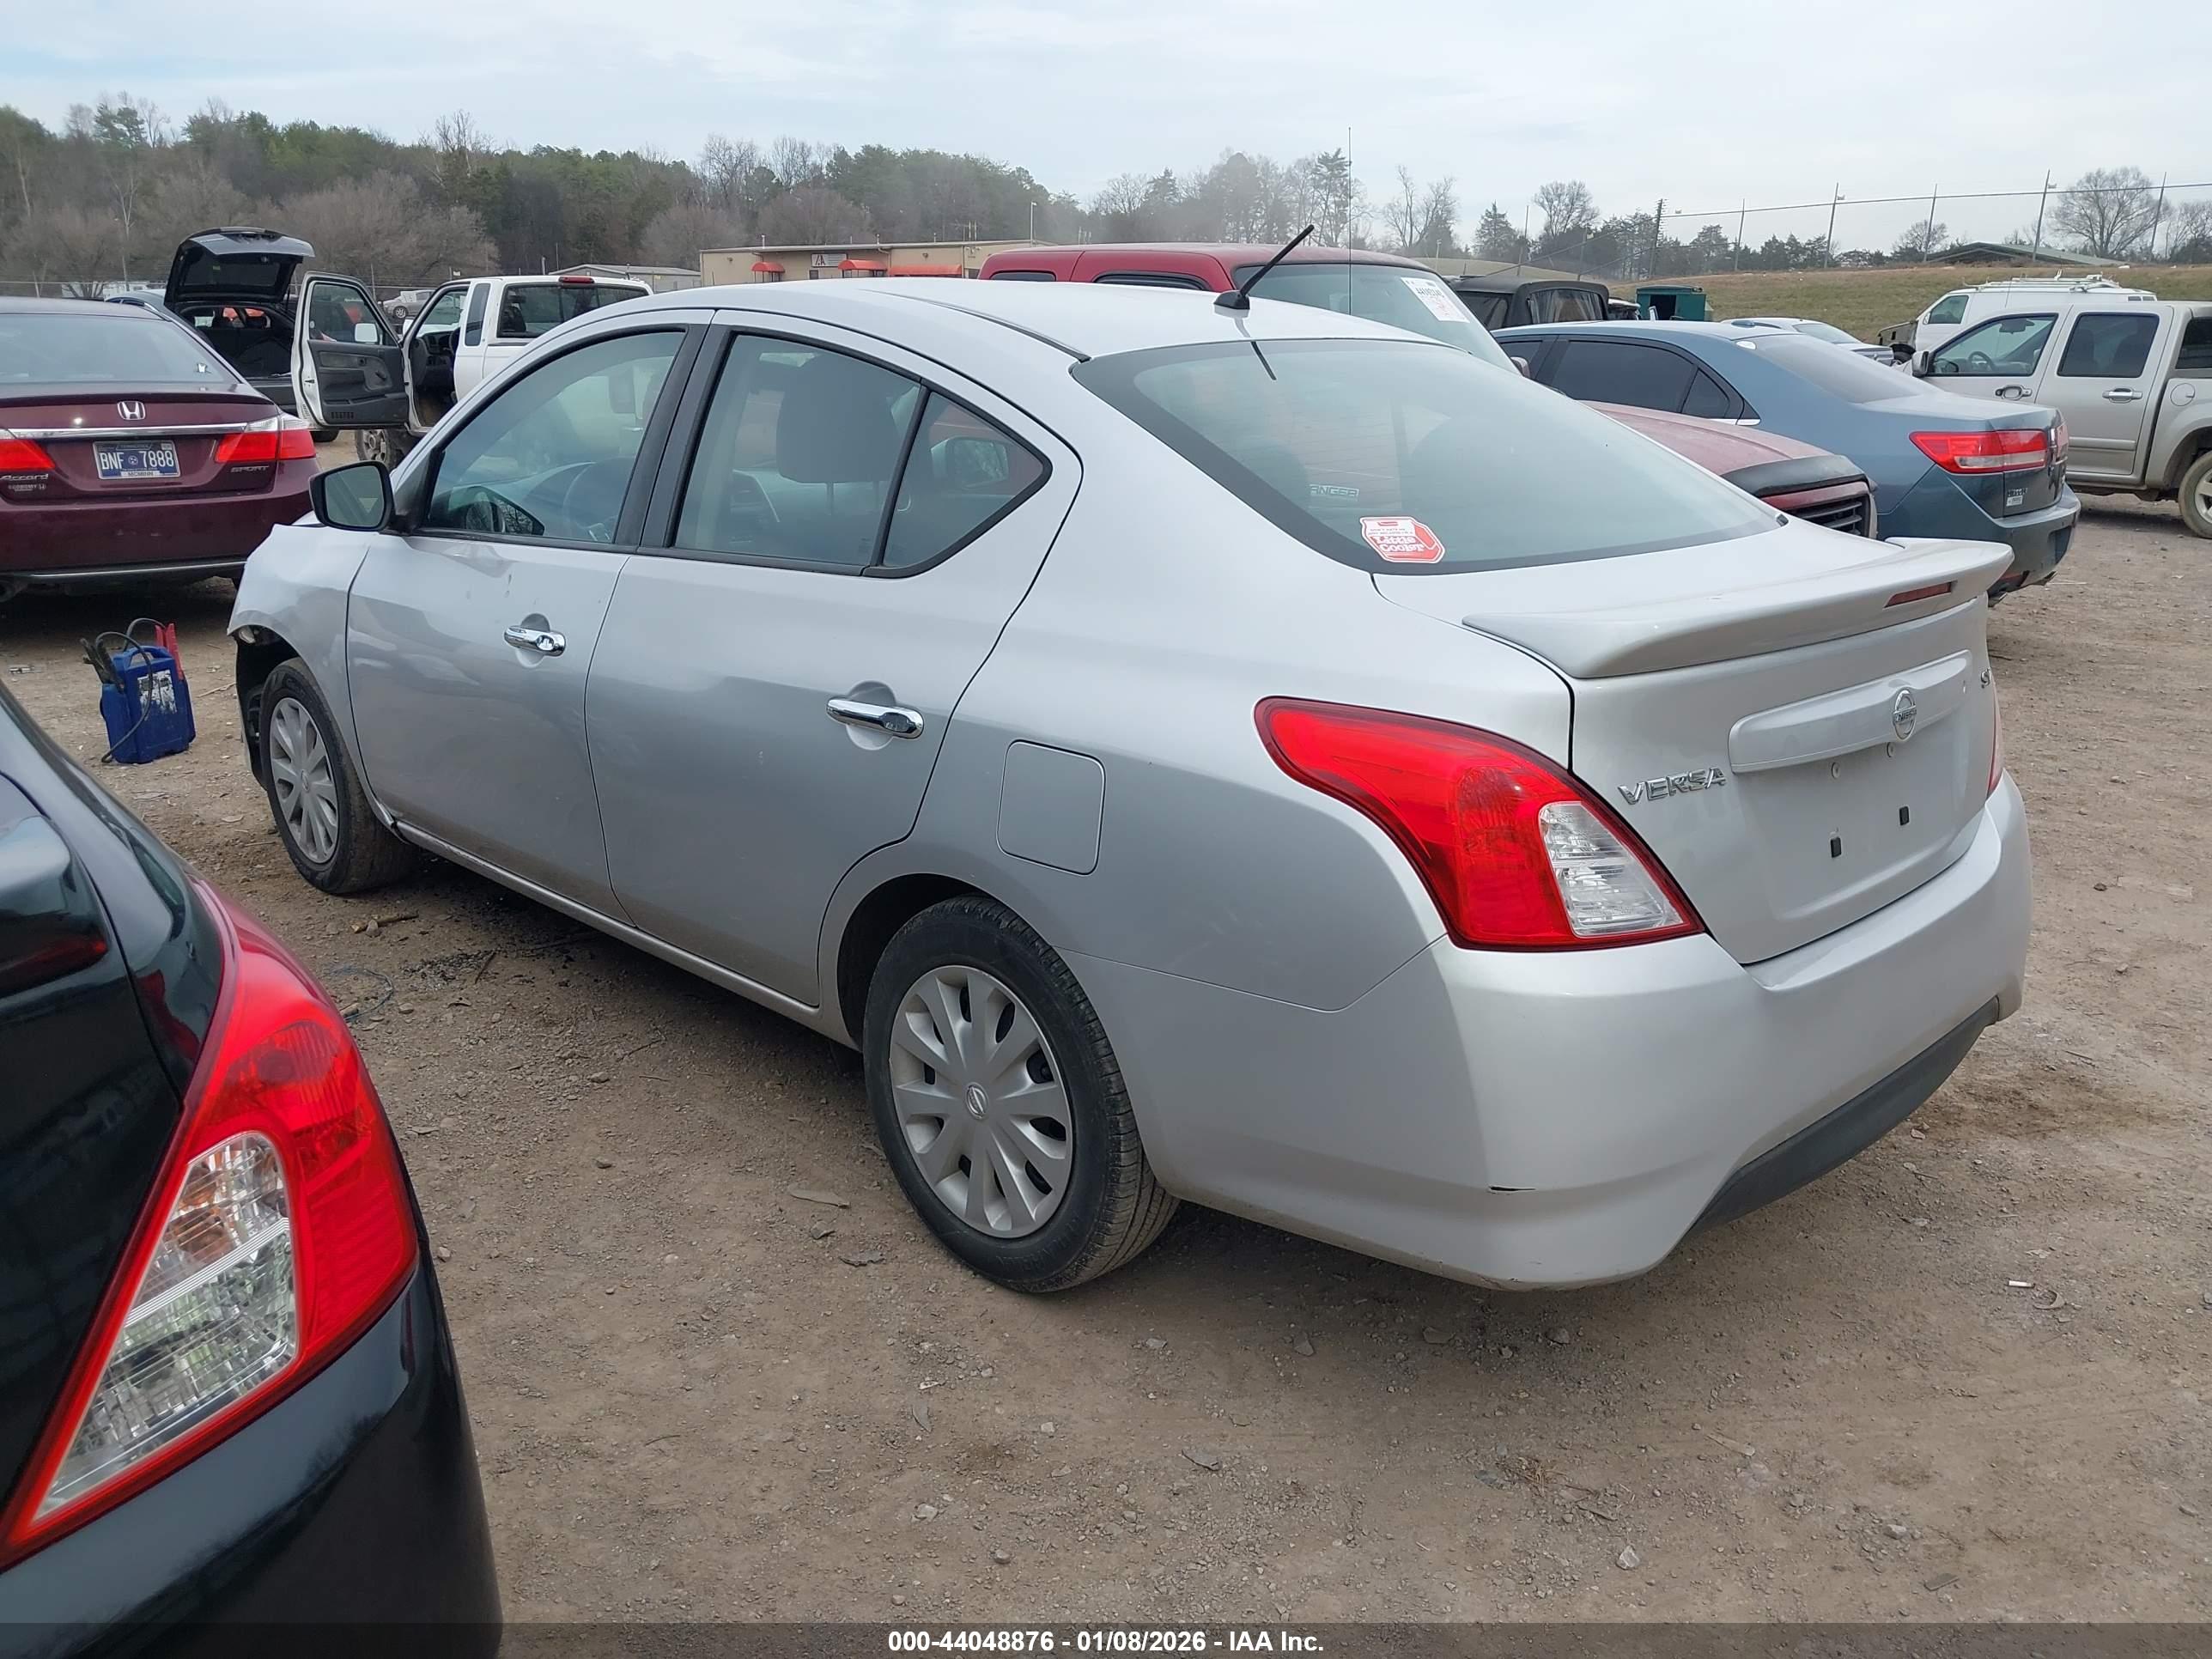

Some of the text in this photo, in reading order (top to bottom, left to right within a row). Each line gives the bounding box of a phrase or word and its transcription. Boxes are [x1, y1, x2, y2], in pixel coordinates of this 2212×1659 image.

[99, 450, 174, 470] BNF 7888
[1379, 543, 1426, 552] Cooler
[1618, 766, 1727, 805] VERSA
